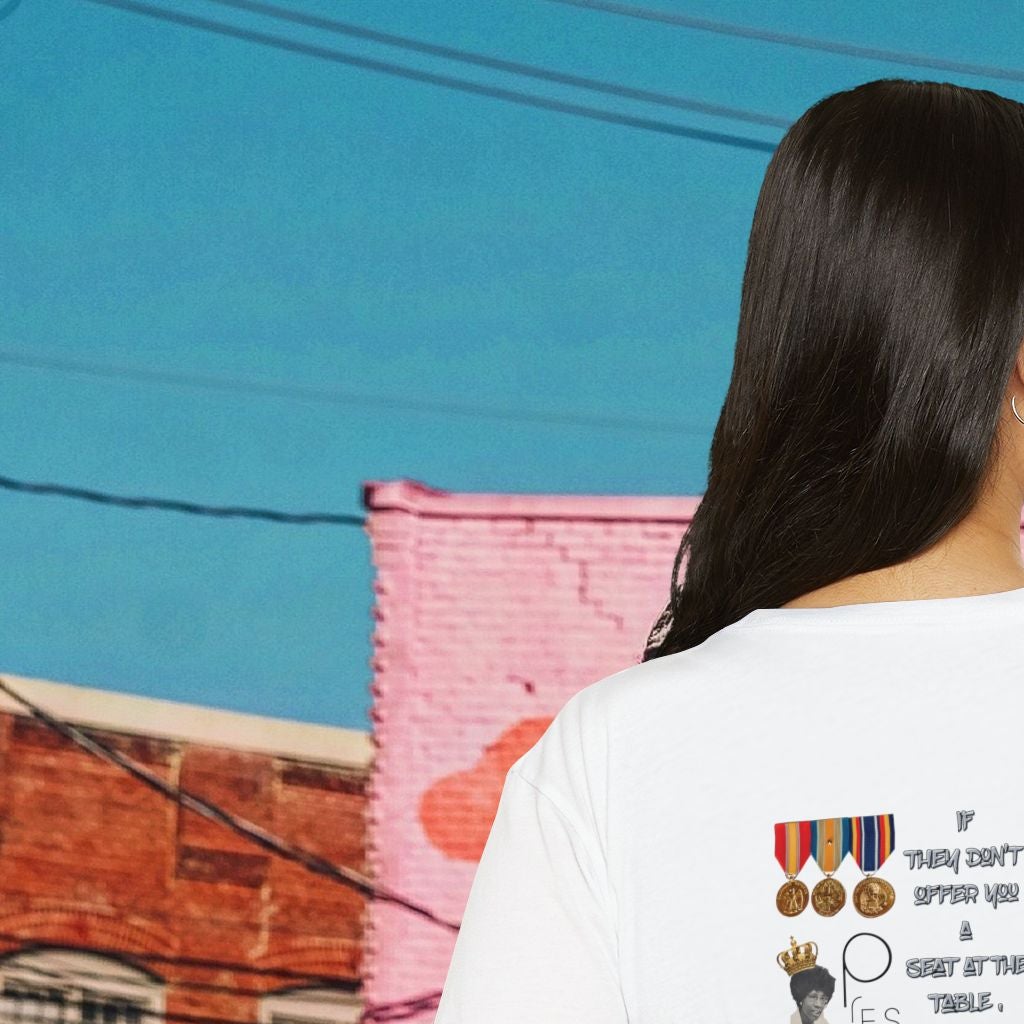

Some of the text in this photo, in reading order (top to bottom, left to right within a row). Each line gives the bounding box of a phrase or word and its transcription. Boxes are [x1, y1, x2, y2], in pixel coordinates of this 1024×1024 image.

[956, 810, 975, 833] IF
[903, 843, 1024, 875] THEY DON'T
[914, 883, 1019, 910] OFFER YOU
[959, 921, 973, 941] A
[906, 957, 961, 979] SEAT
[963, 956, 989, 977] AT
